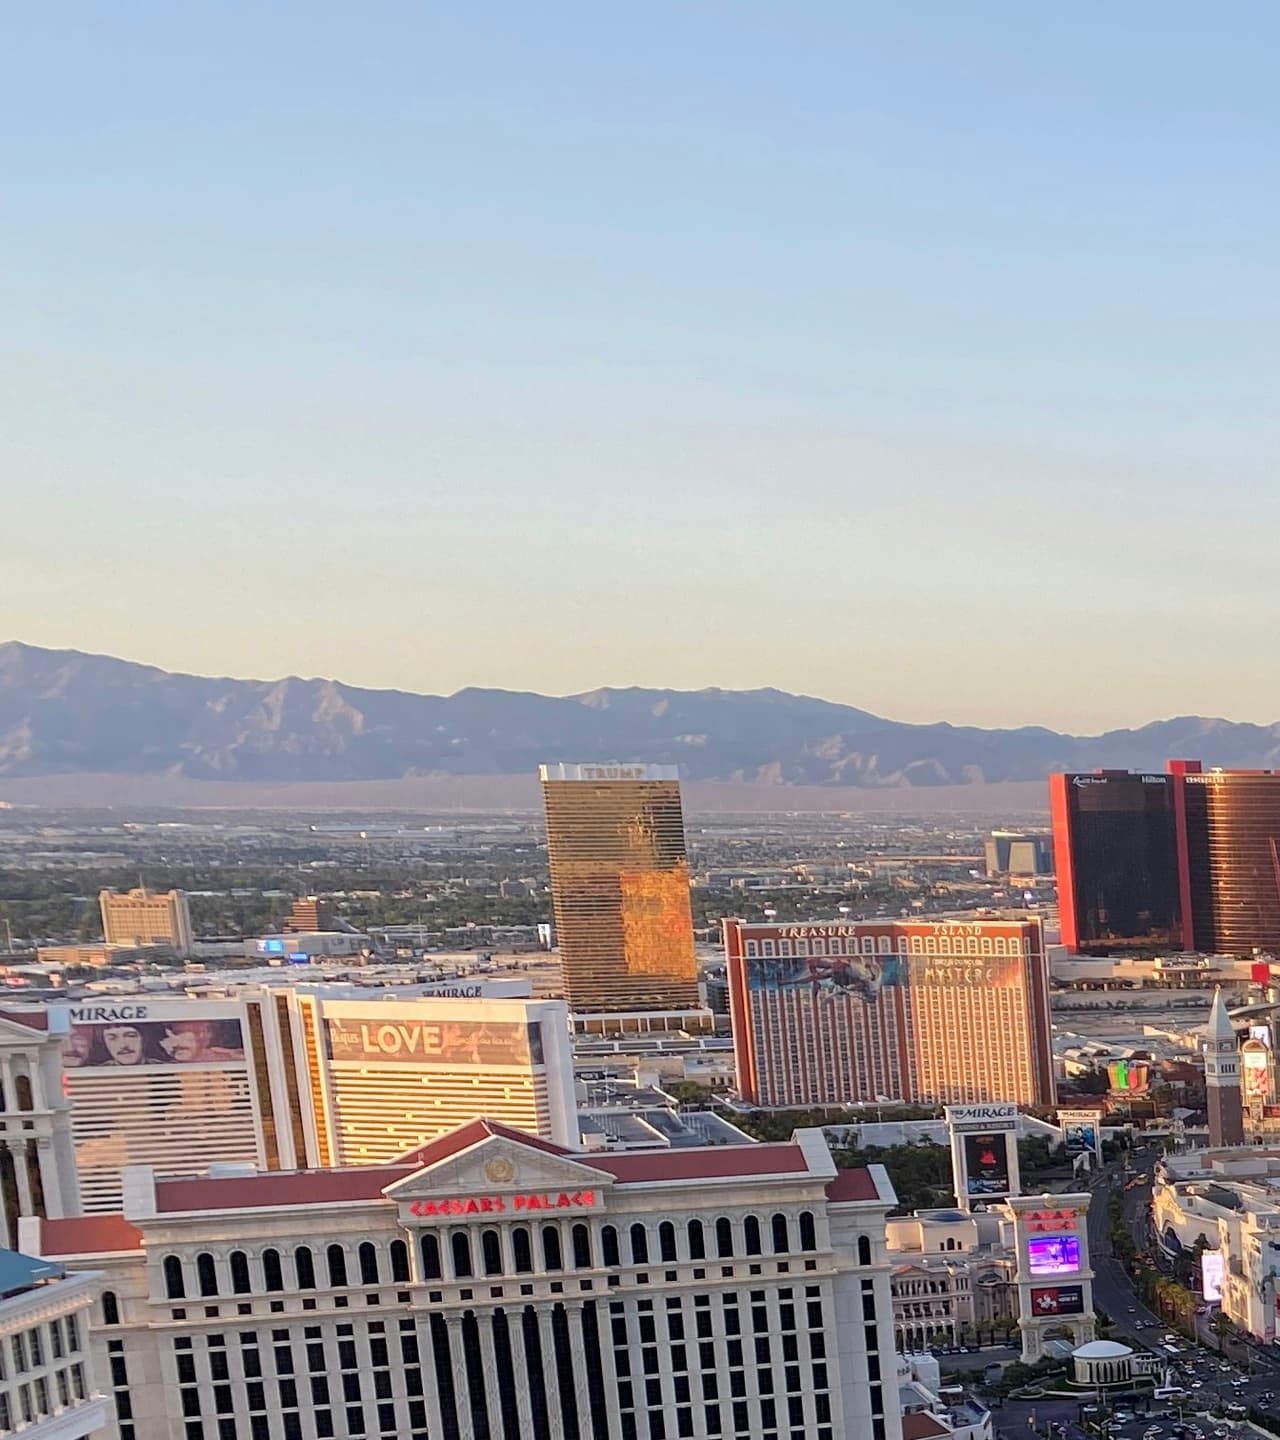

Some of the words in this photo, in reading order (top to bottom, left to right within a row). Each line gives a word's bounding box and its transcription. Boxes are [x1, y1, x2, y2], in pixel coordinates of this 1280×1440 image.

[583, 767, 644, 778] TRUMP
[778, 926, 856, 938] TREASURE
[932, 926, 982, 936] ISLAND
[434, 985, 482, 998] MIRAGE
[70, 1006, 147, 1022] MIRAGE
[361, 1024, 442, 1055] LOVE
[964, 1107, 1015, 1119] MIRAGE
[410, 1197, 505, 1217] CAESARS
[513, 1191, 595, 1211] PALACE
